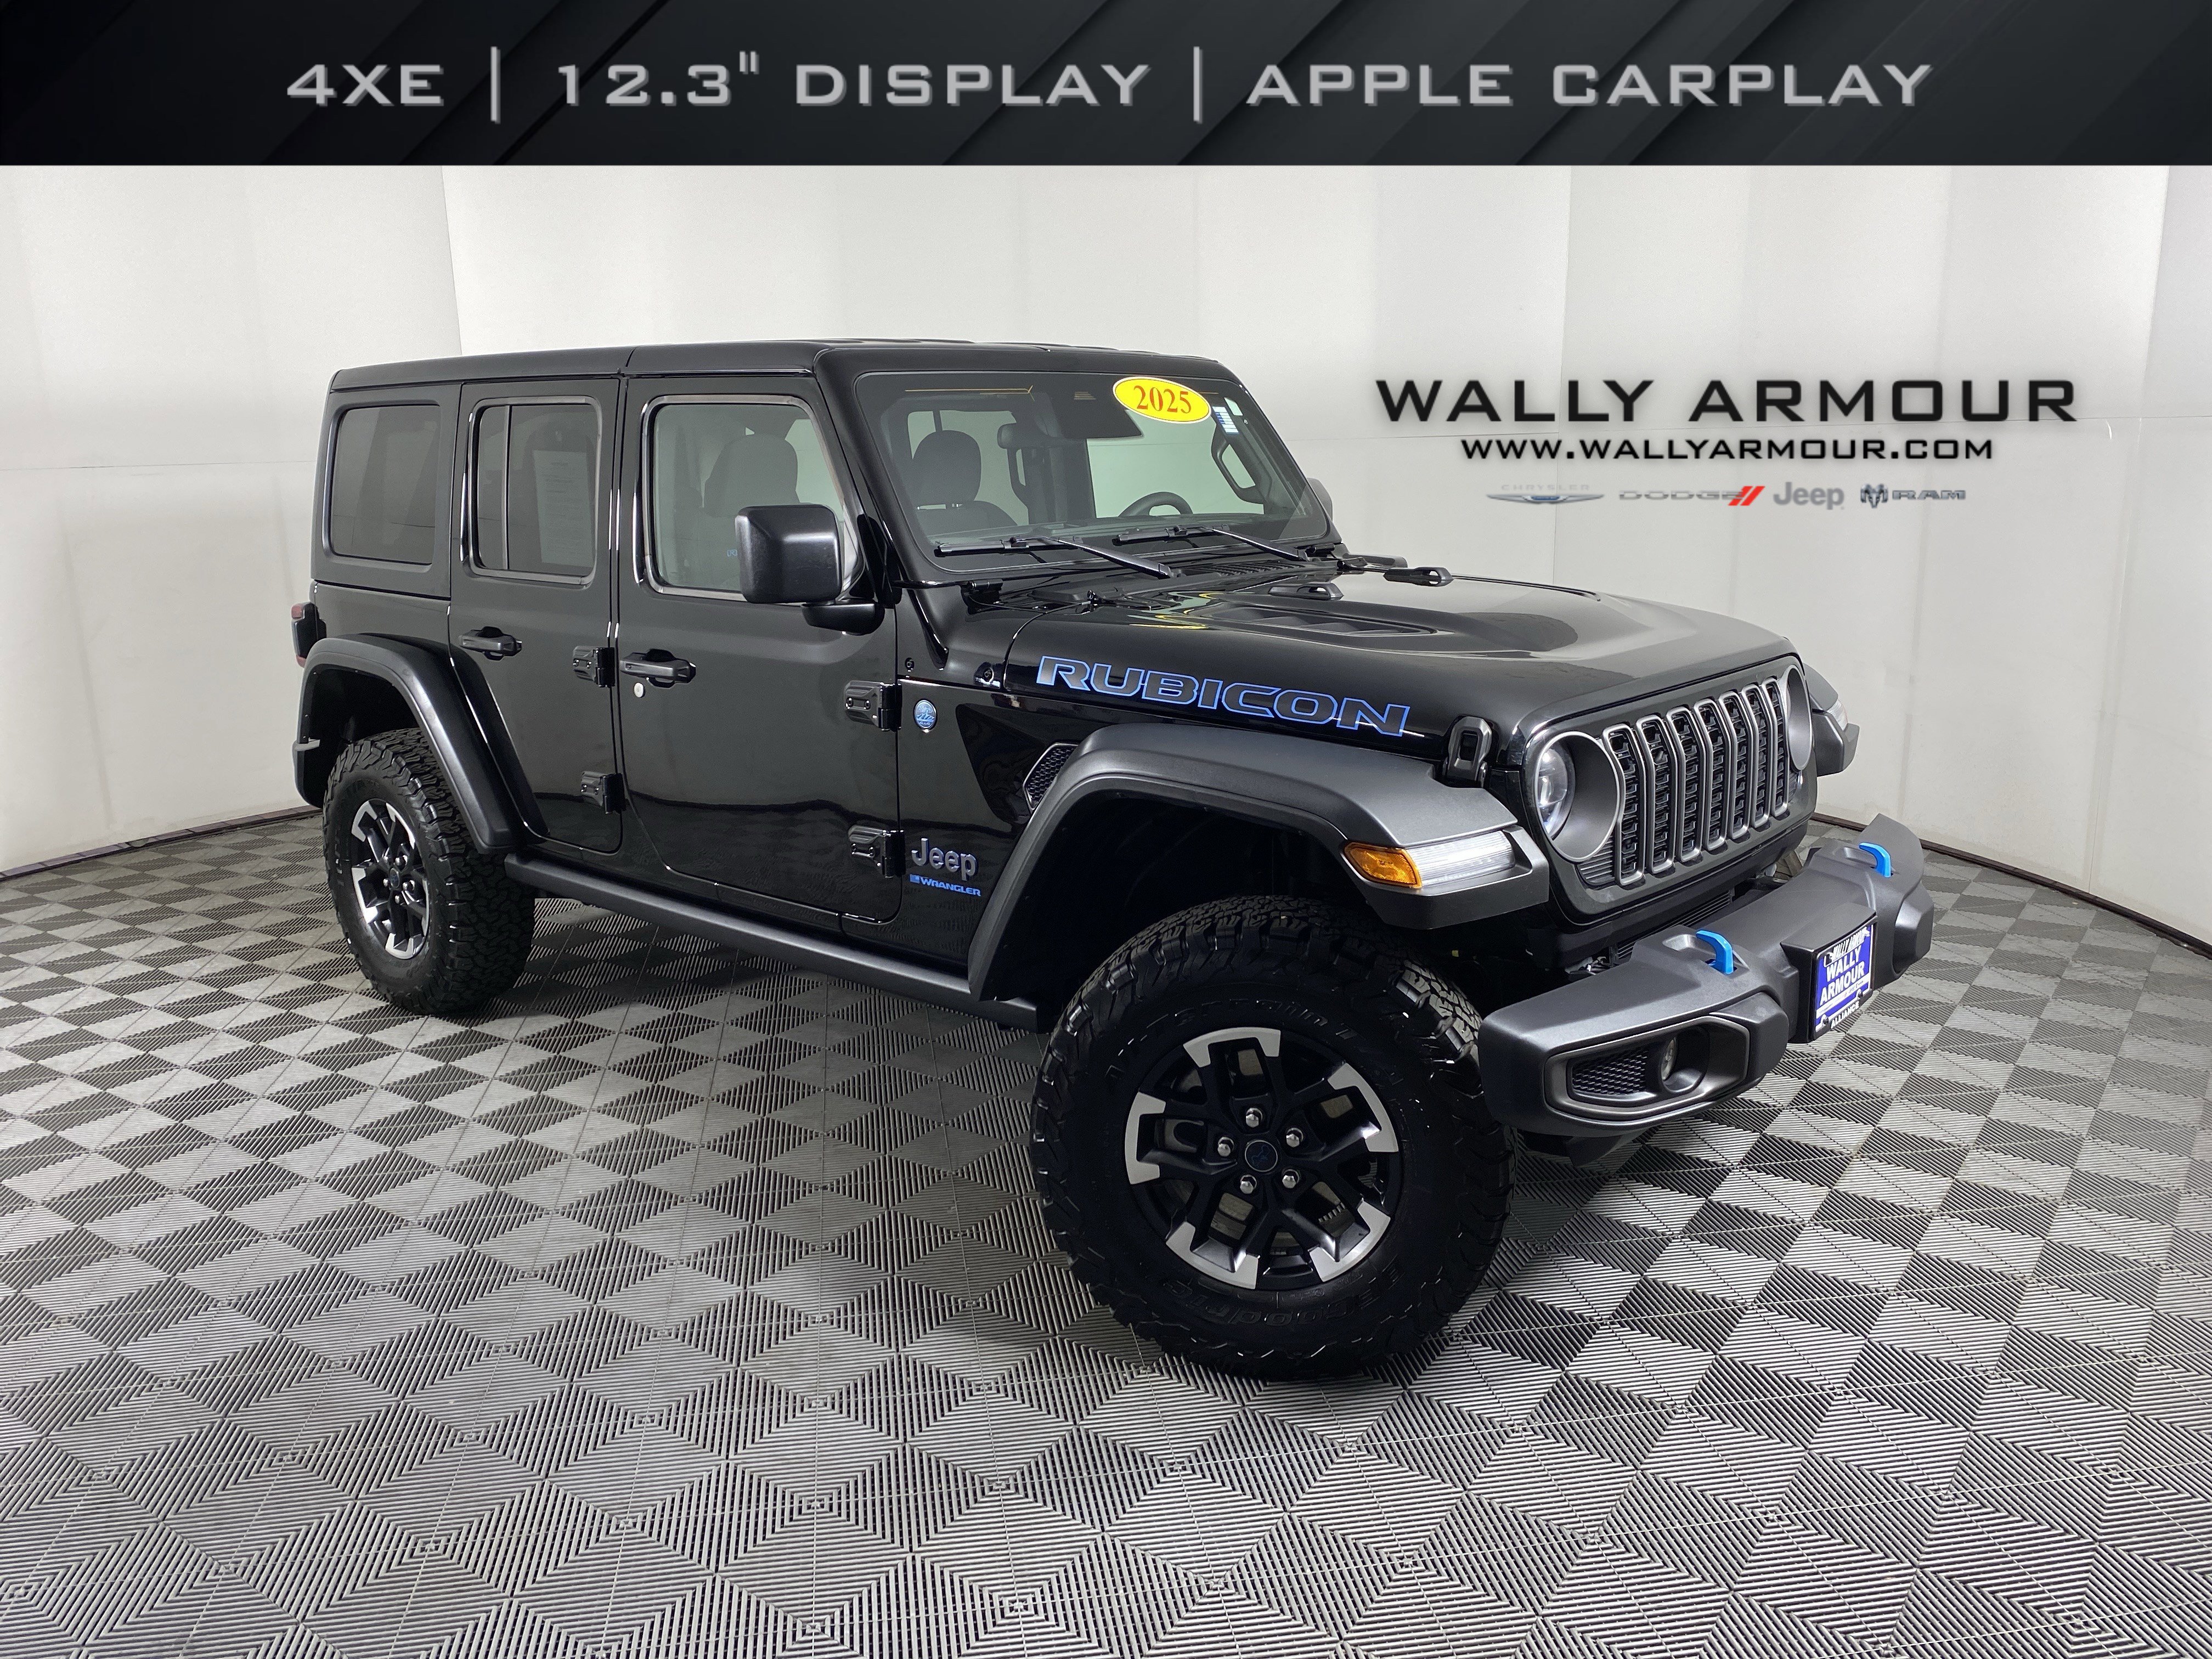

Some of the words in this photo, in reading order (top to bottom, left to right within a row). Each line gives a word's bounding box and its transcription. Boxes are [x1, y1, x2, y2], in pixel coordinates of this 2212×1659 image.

[1133, 385, 1192, 414] 2025
[1036, 656, 1410, 737] RUBICON
[911, 837, 978, 881] Jeep
[919, 876, 981, 897] WRANGLER
[1826, 945, 1862, 983] WALLY
[1819, 961, 1865, 1006] ARMOUR
[1830, 1001, 1860, 1029] ALLIANCE
